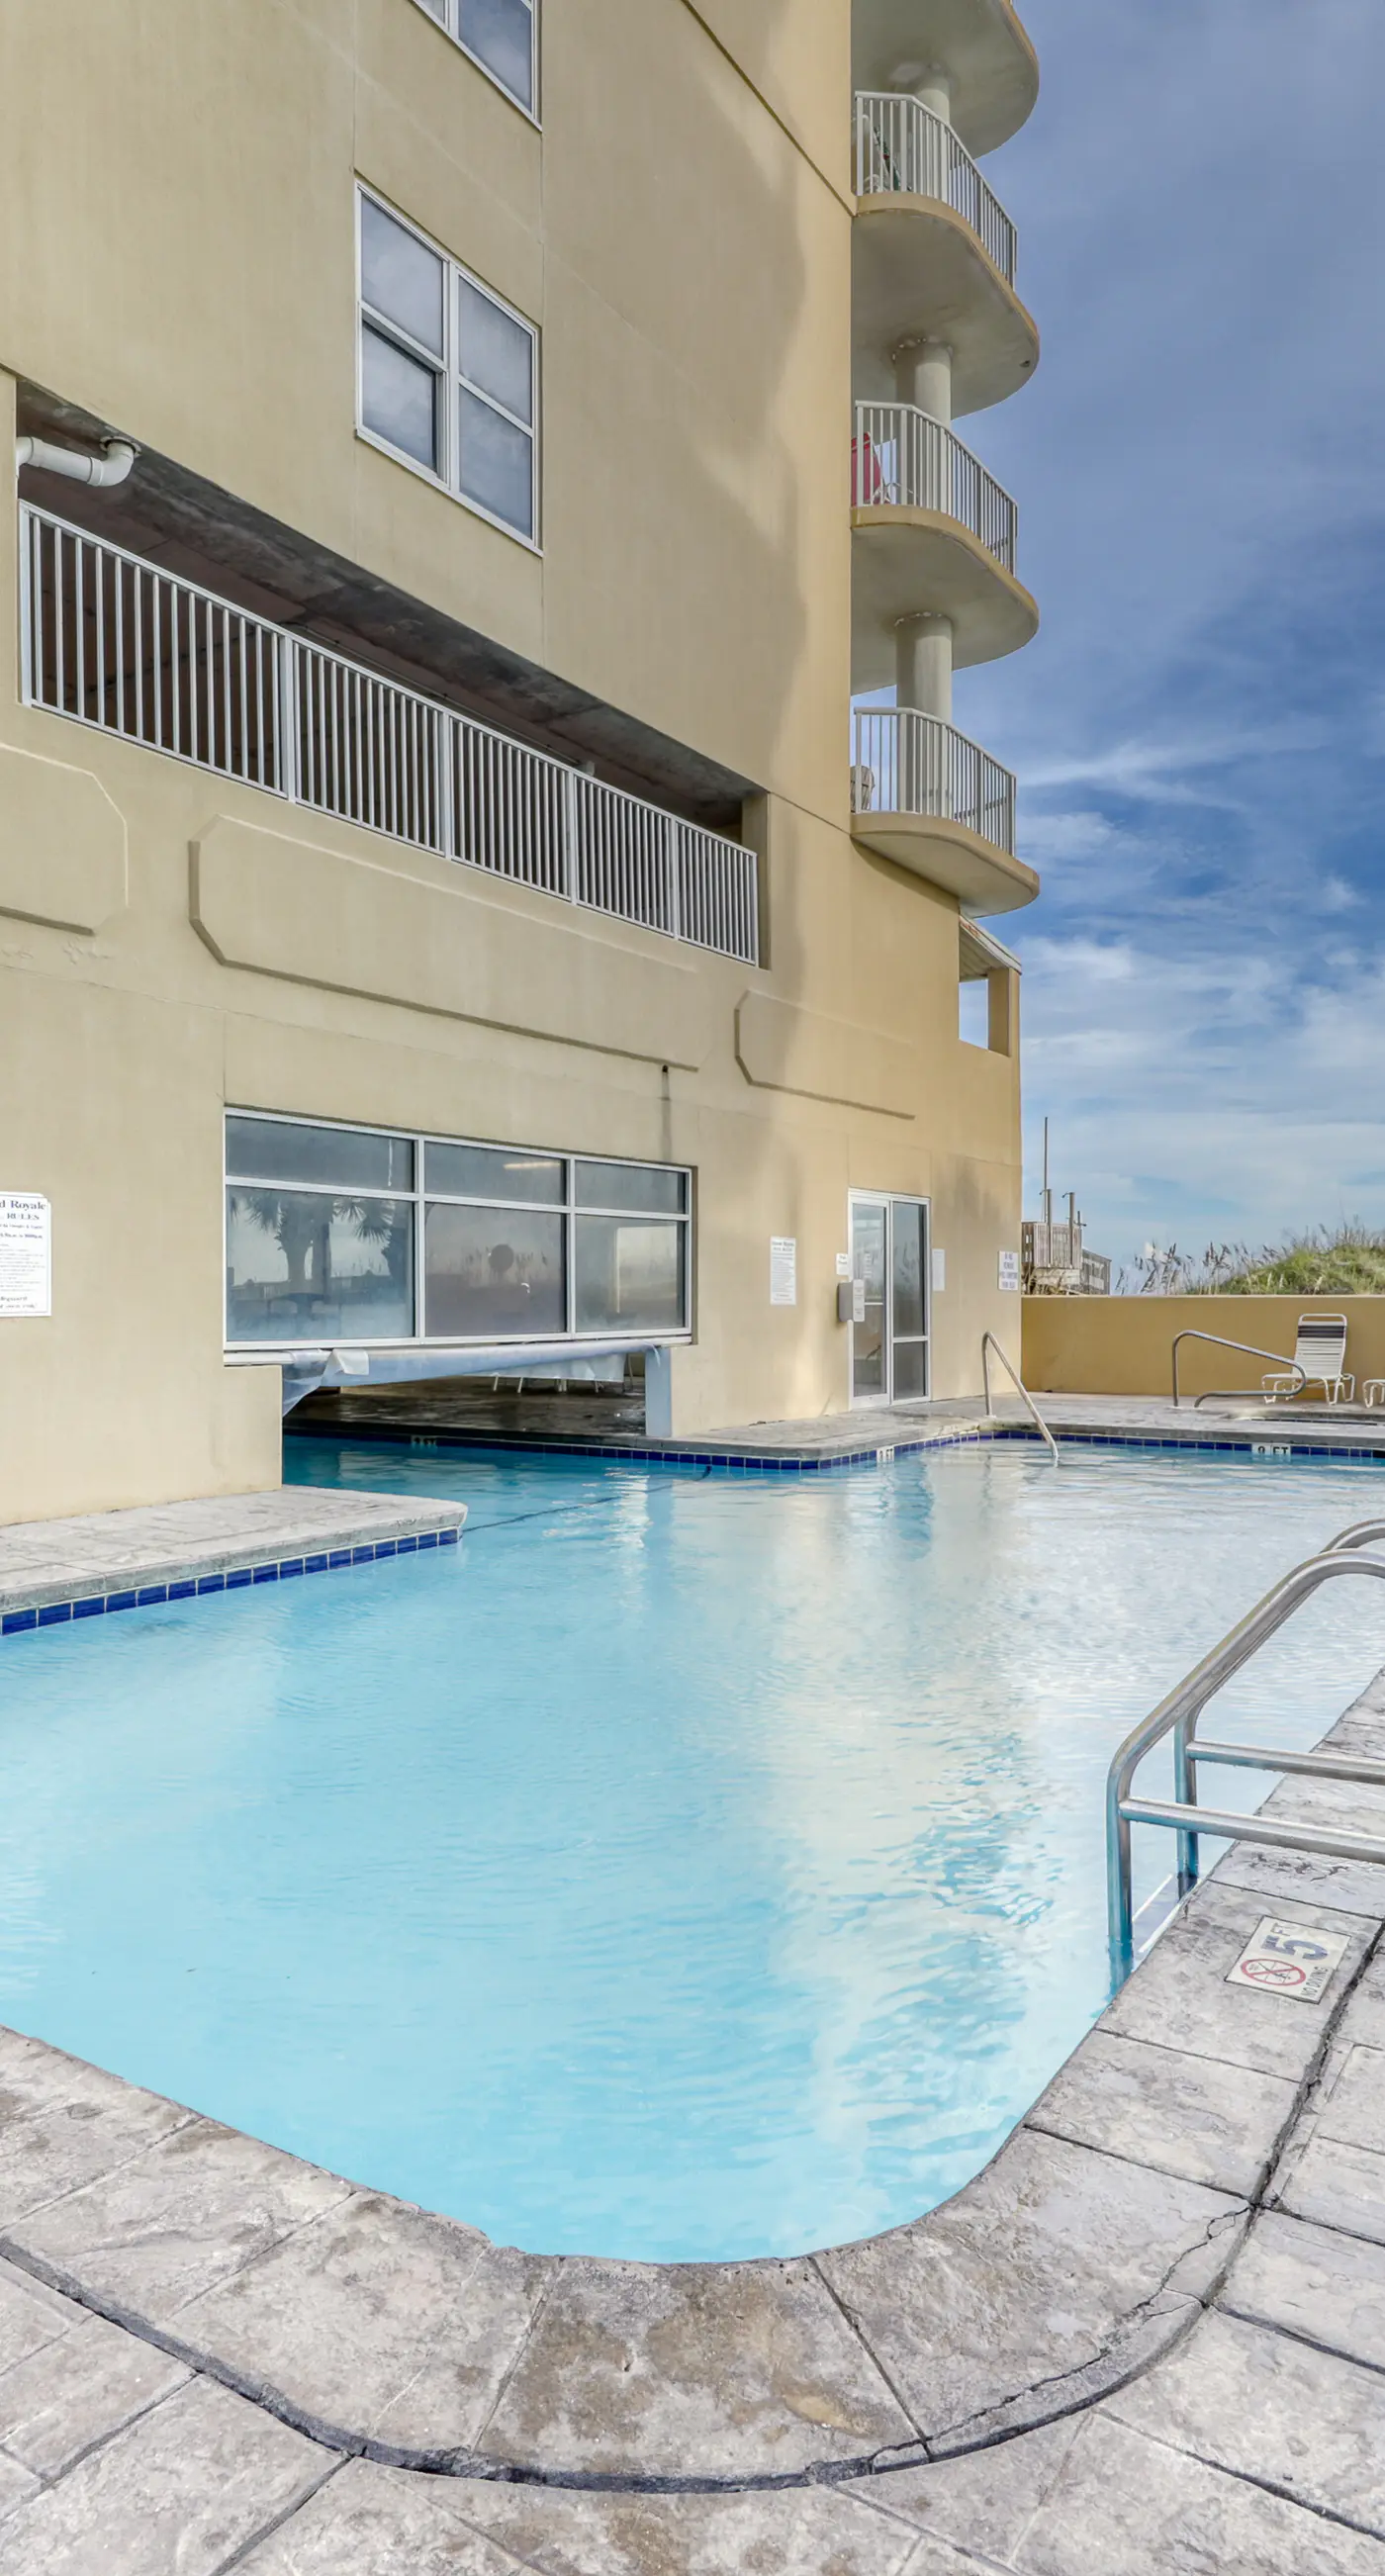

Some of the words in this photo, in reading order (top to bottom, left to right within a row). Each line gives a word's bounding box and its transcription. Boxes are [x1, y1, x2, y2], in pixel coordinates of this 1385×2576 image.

[11, 1200, 46, 1212] Royale
[1260, 1935, 1329, 1961] 5
[1305, 1966, 1330, 1989] DIVING
[1300, 1988, 1316, 1997] NO
